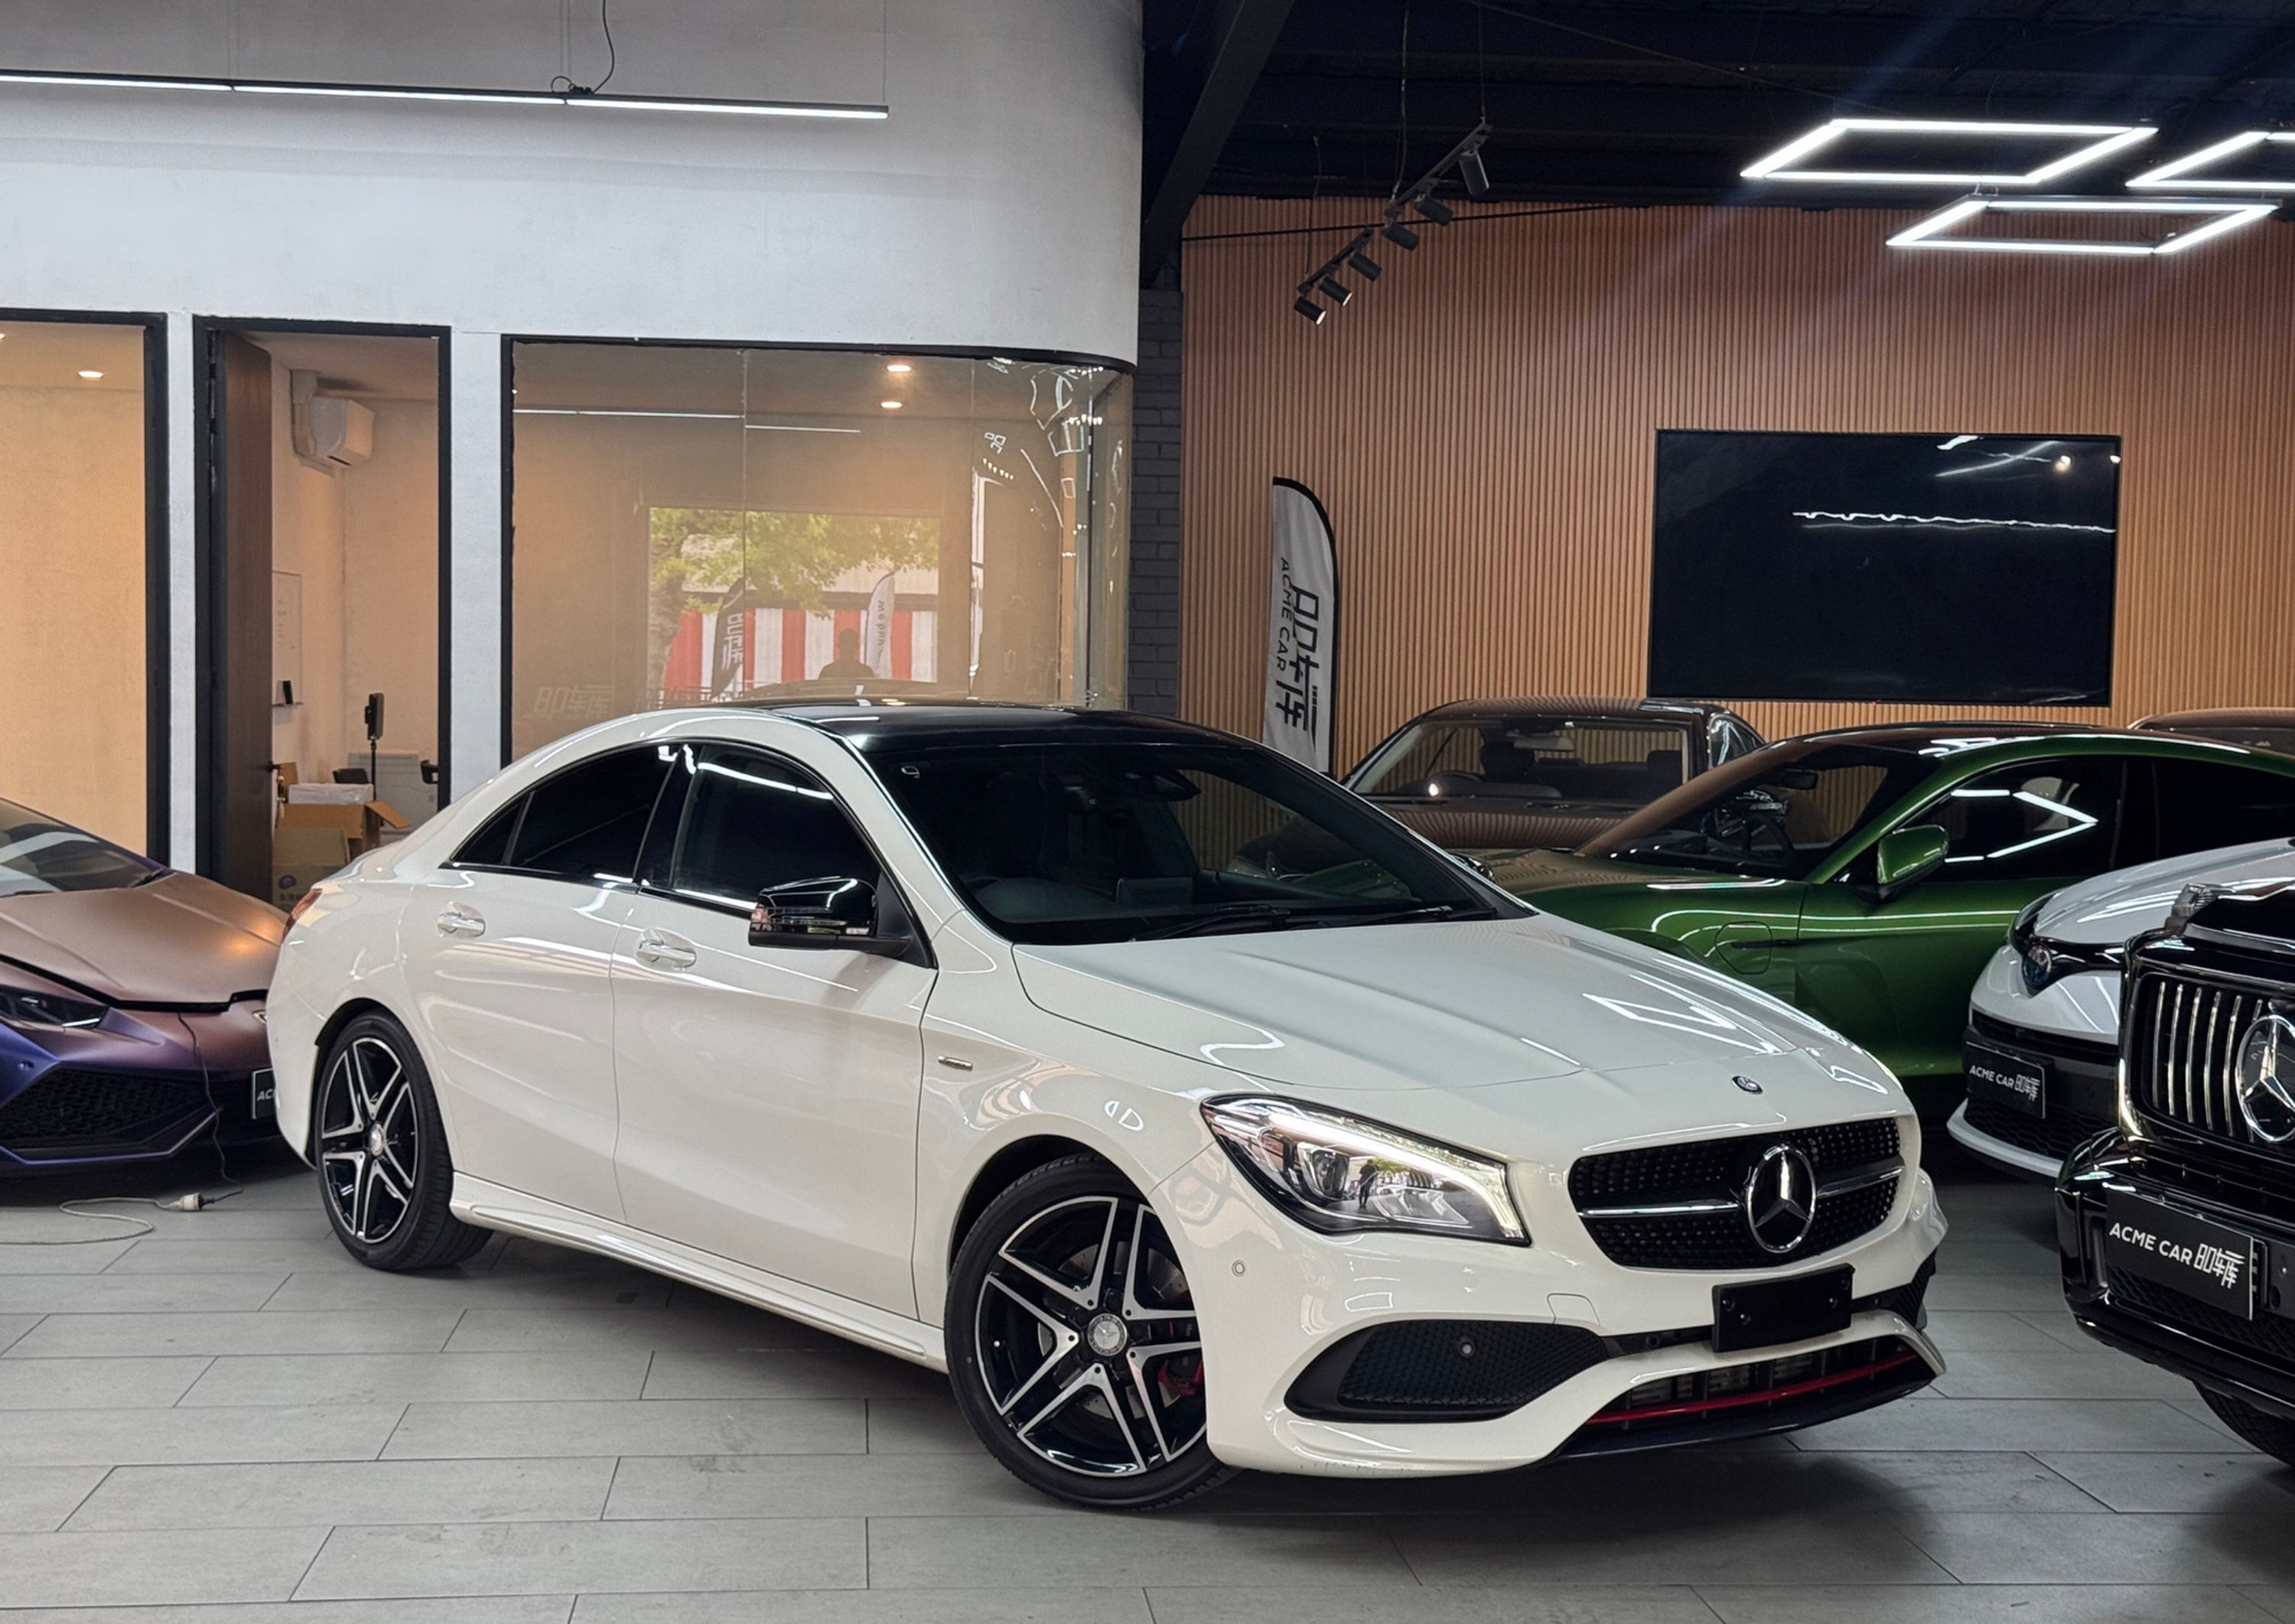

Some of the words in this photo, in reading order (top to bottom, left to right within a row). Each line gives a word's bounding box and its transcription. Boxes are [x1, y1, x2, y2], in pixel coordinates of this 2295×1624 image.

[1281, 557, 1292, 622] ACME
[1276, 626, 1291, 672] CAR
[1969, 1065, 1995, 1082] ACME
[1996, 1074, 2014, 1089] CAR
[2109, 1222, 2157, 1251] ACME
[2159, 1241, 2193, 1266] CAR
